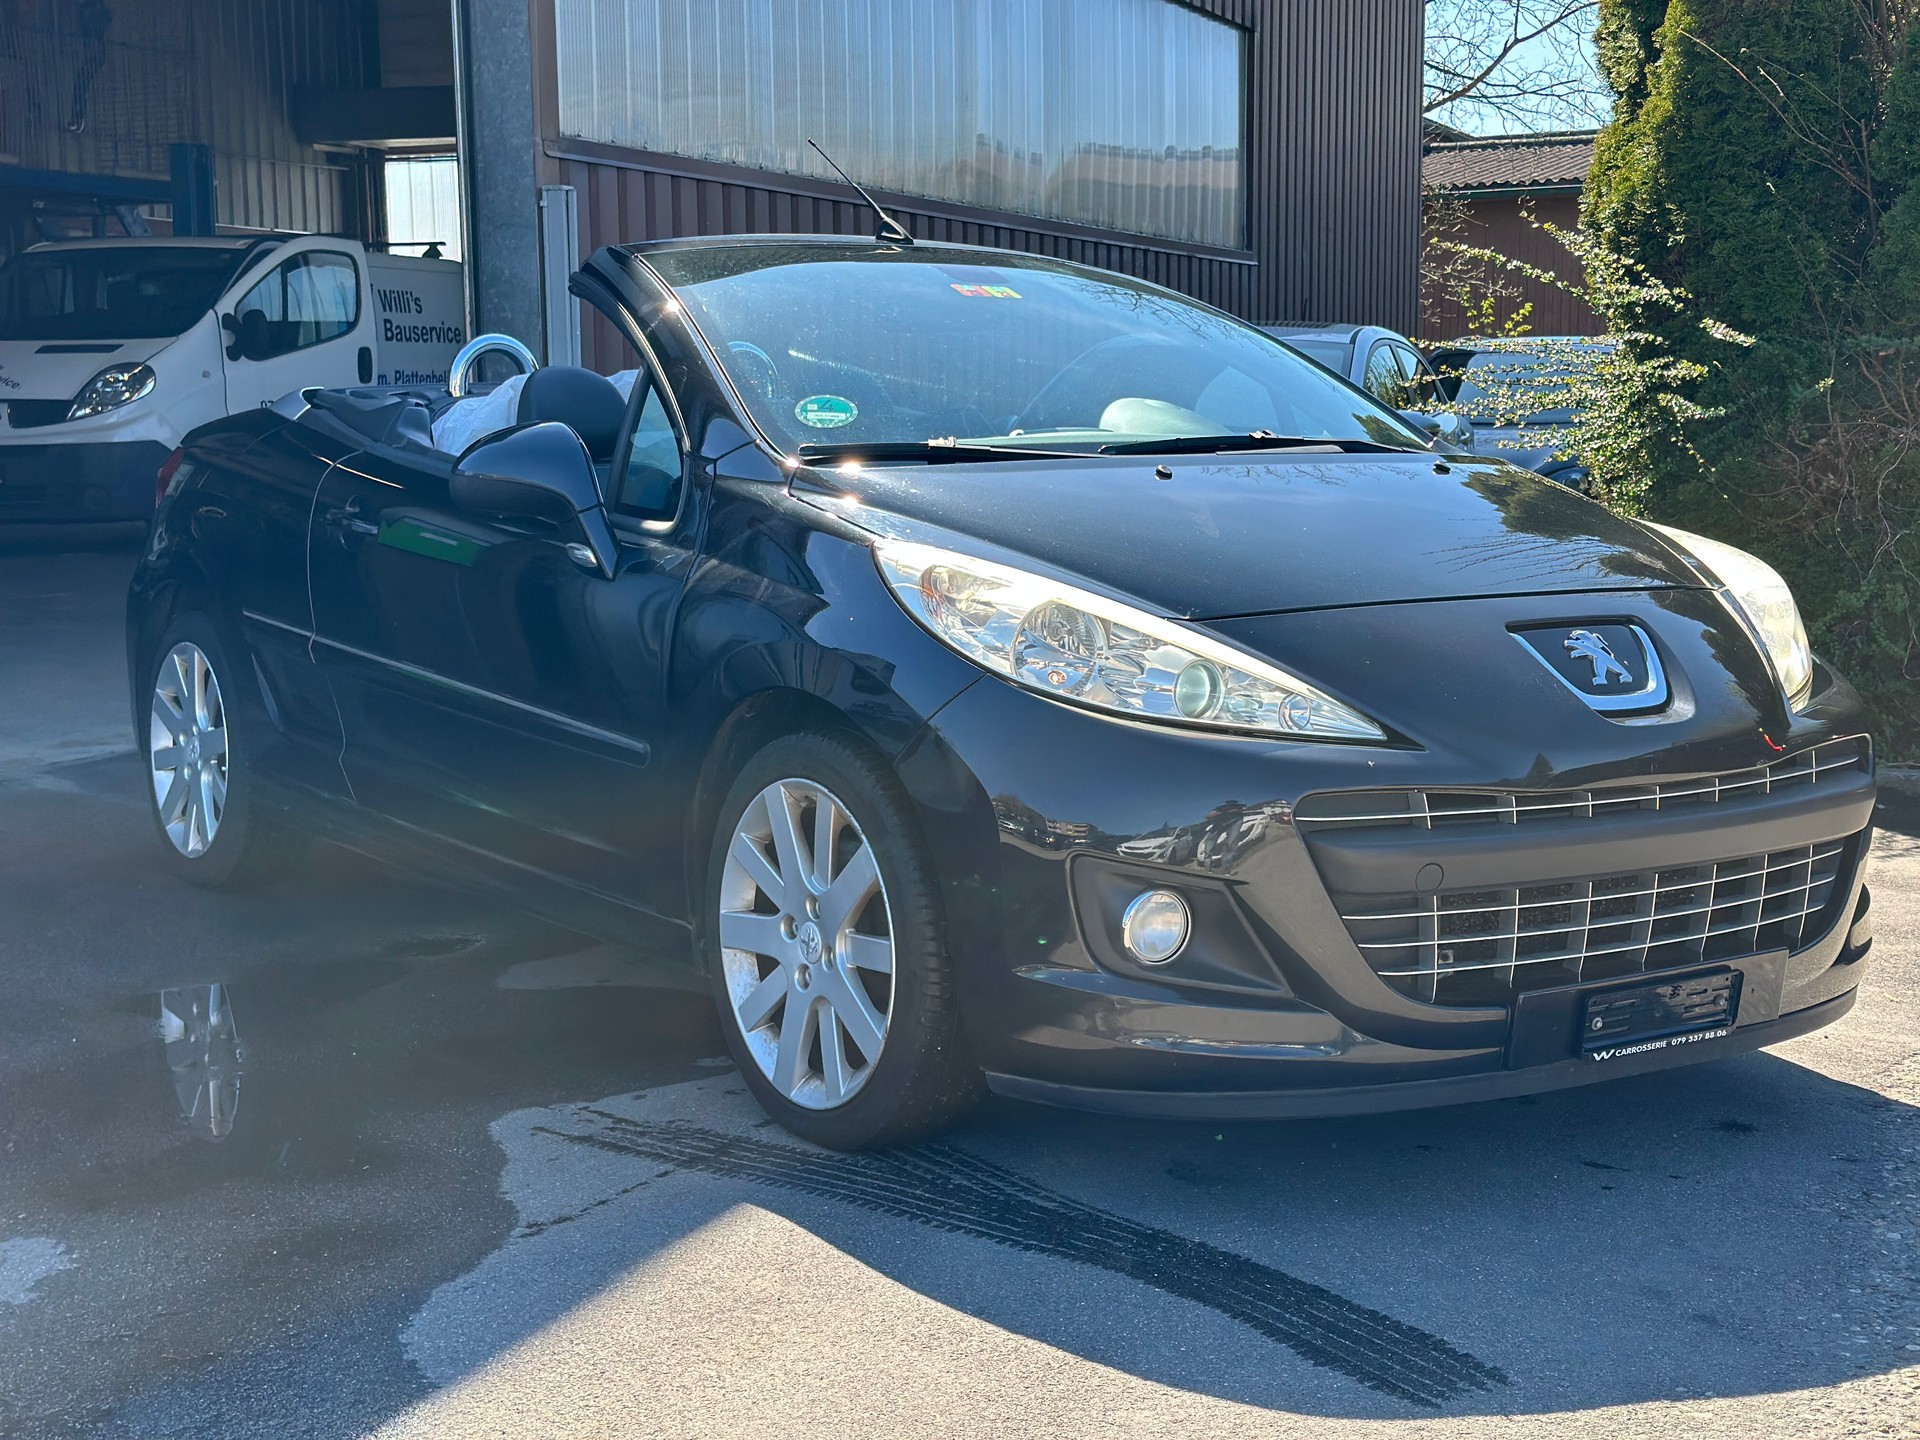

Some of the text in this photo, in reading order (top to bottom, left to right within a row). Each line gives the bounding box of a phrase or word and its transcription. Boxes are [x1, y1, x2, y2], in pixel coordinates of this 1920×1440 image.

[378, 289, 423, 315] Willi's
[383, 318, 462, 344] Bauservice
[378, 373, 391, 386] m.
[1615, 1040, 1668, 1057] CARROSSERIE
[1671, 1036, 1687, 1046] 079
[1688, 1033, 1704, 1043] 337
[1705, 1031, 1715, 1040] 88
[1716, 1029, 1727, 1037] 06
